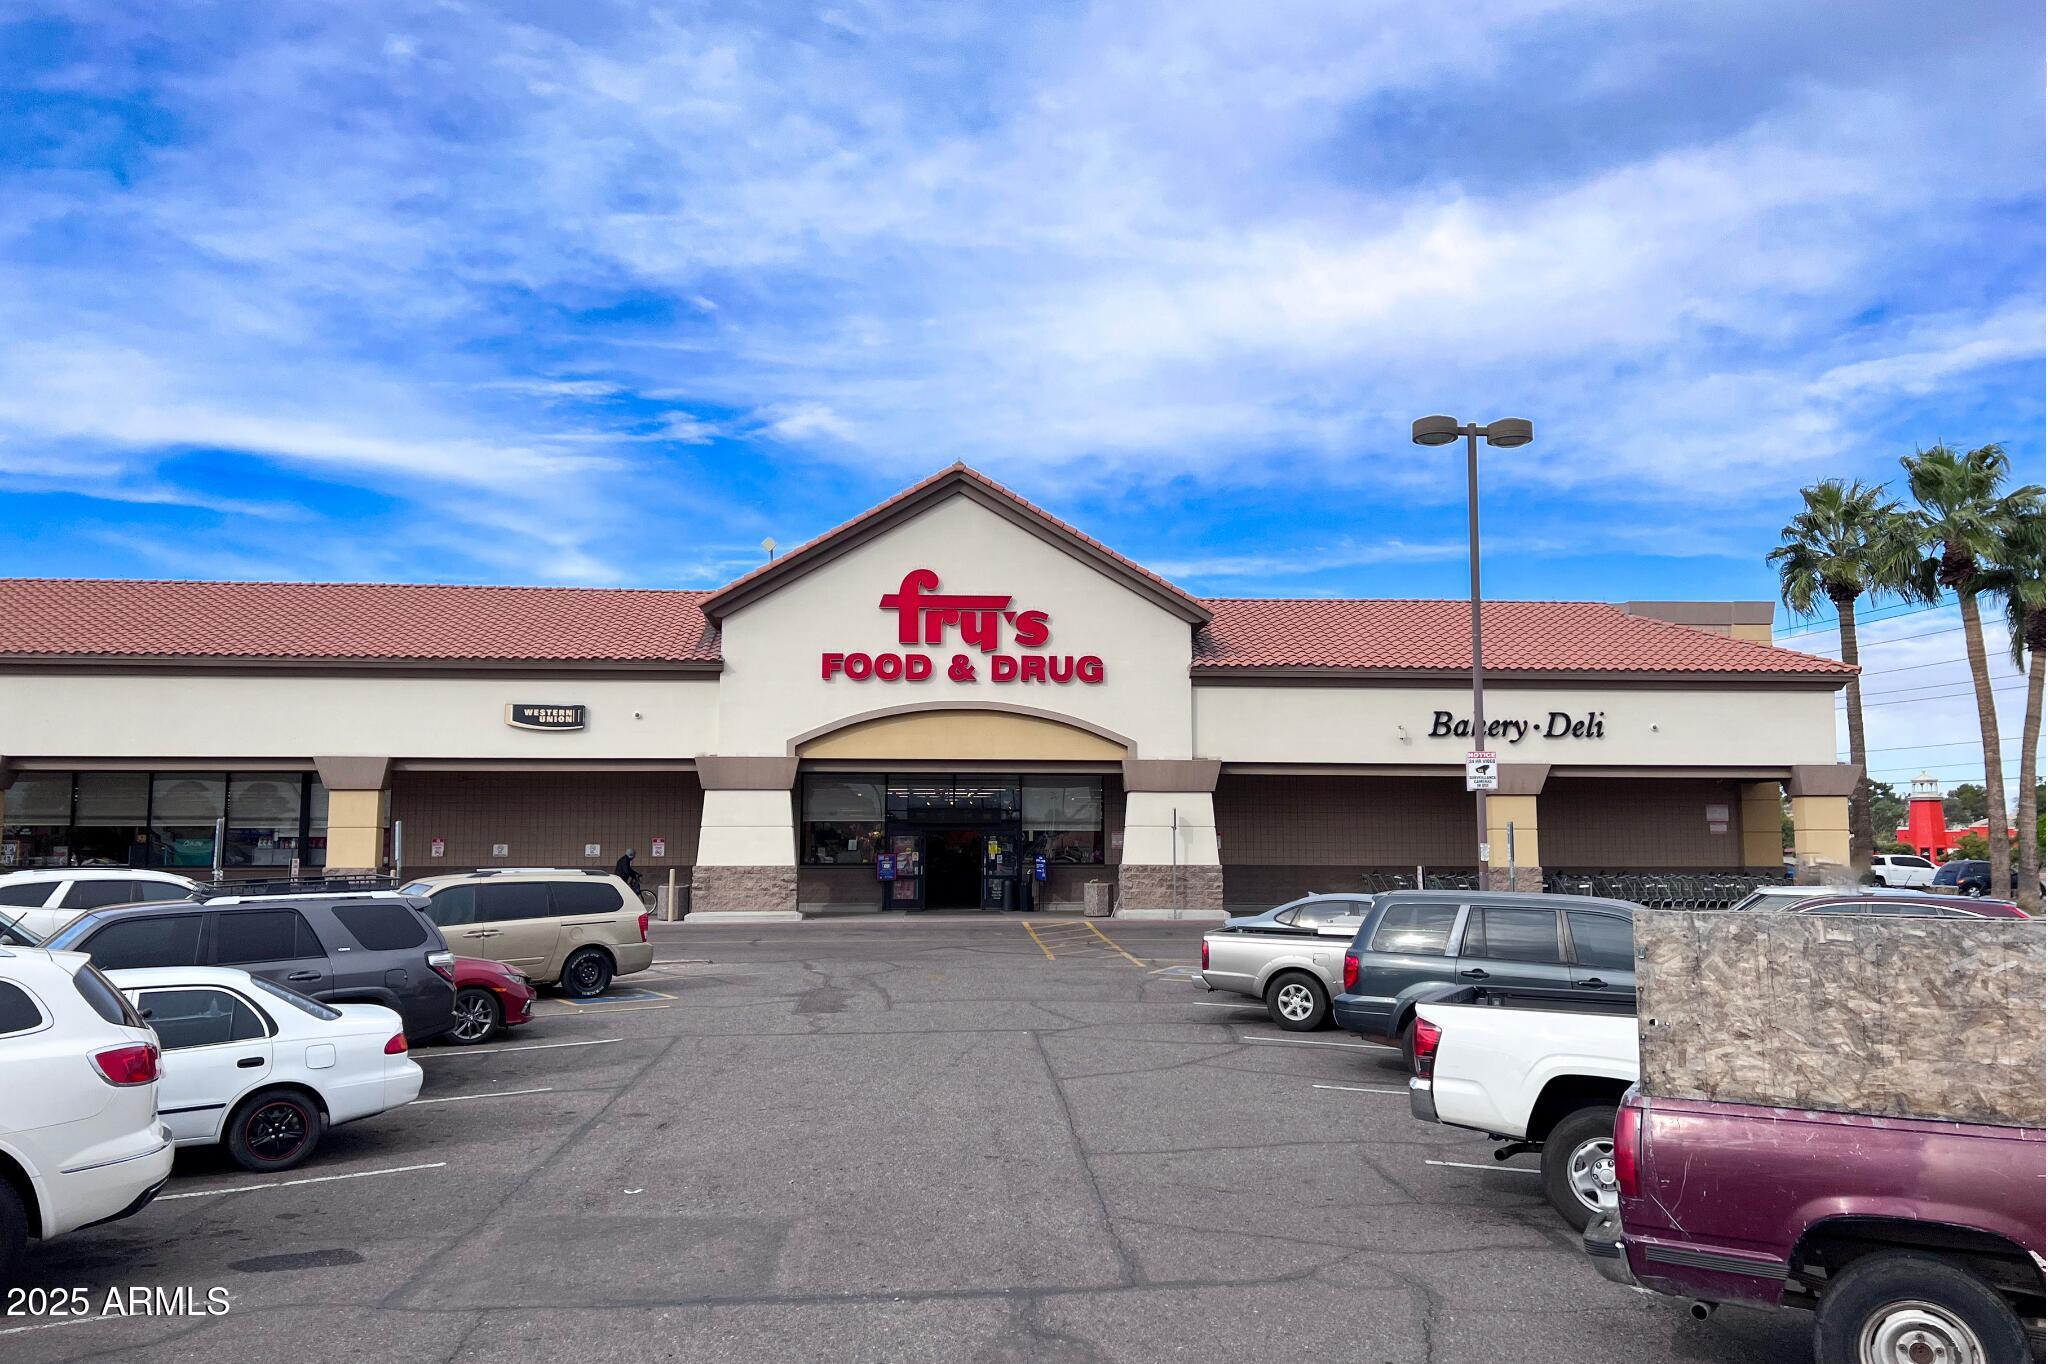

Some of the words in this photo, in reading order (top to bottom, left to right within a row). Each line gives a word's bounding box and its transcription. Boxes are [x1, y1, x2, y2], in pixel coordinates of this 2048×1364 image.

[879, 568, 1050, 654] fry's
[821, 652, 934, 682] FOOD
[947, 653, 978, 683] &
[991, 655, 1105, 684] DRUG
[1543, 711, 1605, 739] Deli
